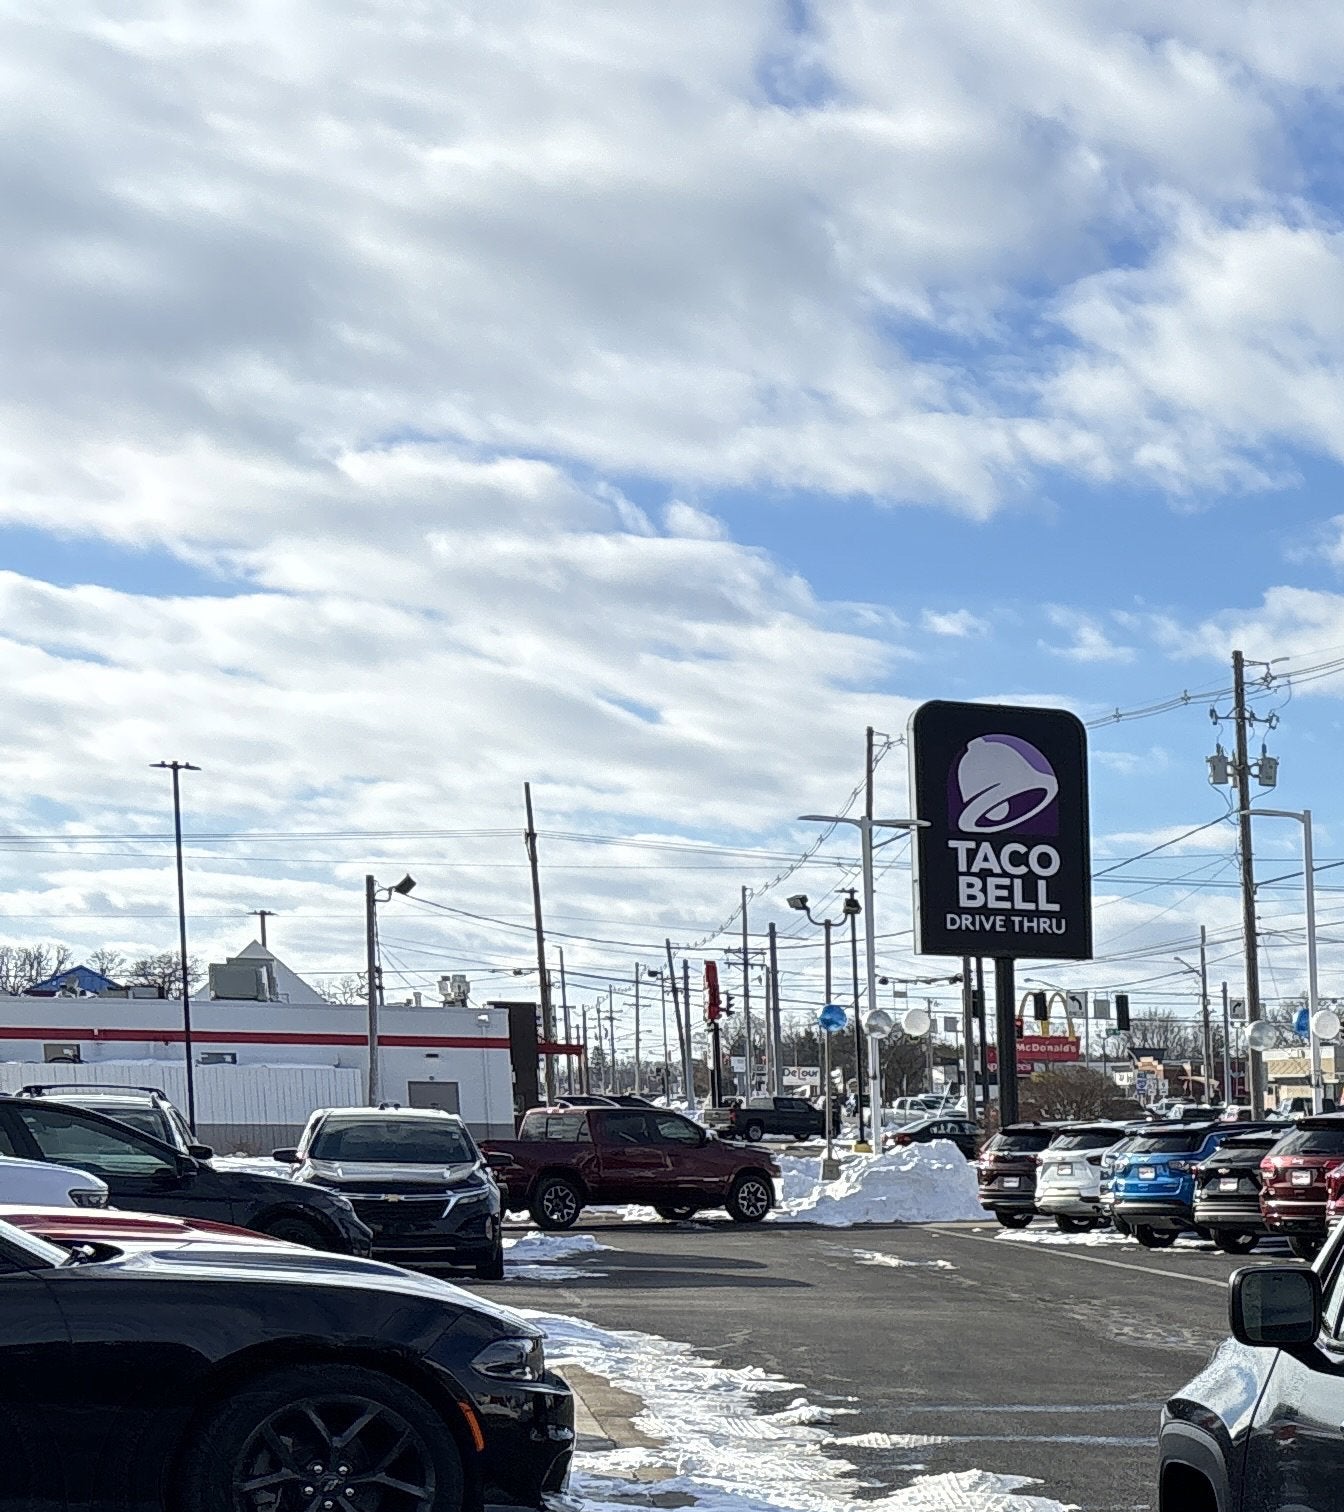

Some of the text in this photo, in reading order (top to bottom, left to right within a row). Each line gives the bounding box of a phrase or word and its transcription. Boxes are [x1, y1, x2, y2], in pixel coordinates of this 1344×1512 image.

[948, 840, 1061, 877] TACO
[958, 876, 1061, 911] BELL
[946, 913, 1066, 934] DRIVE THRU
[1016, 1043, 1077, 1053] McDonald's
